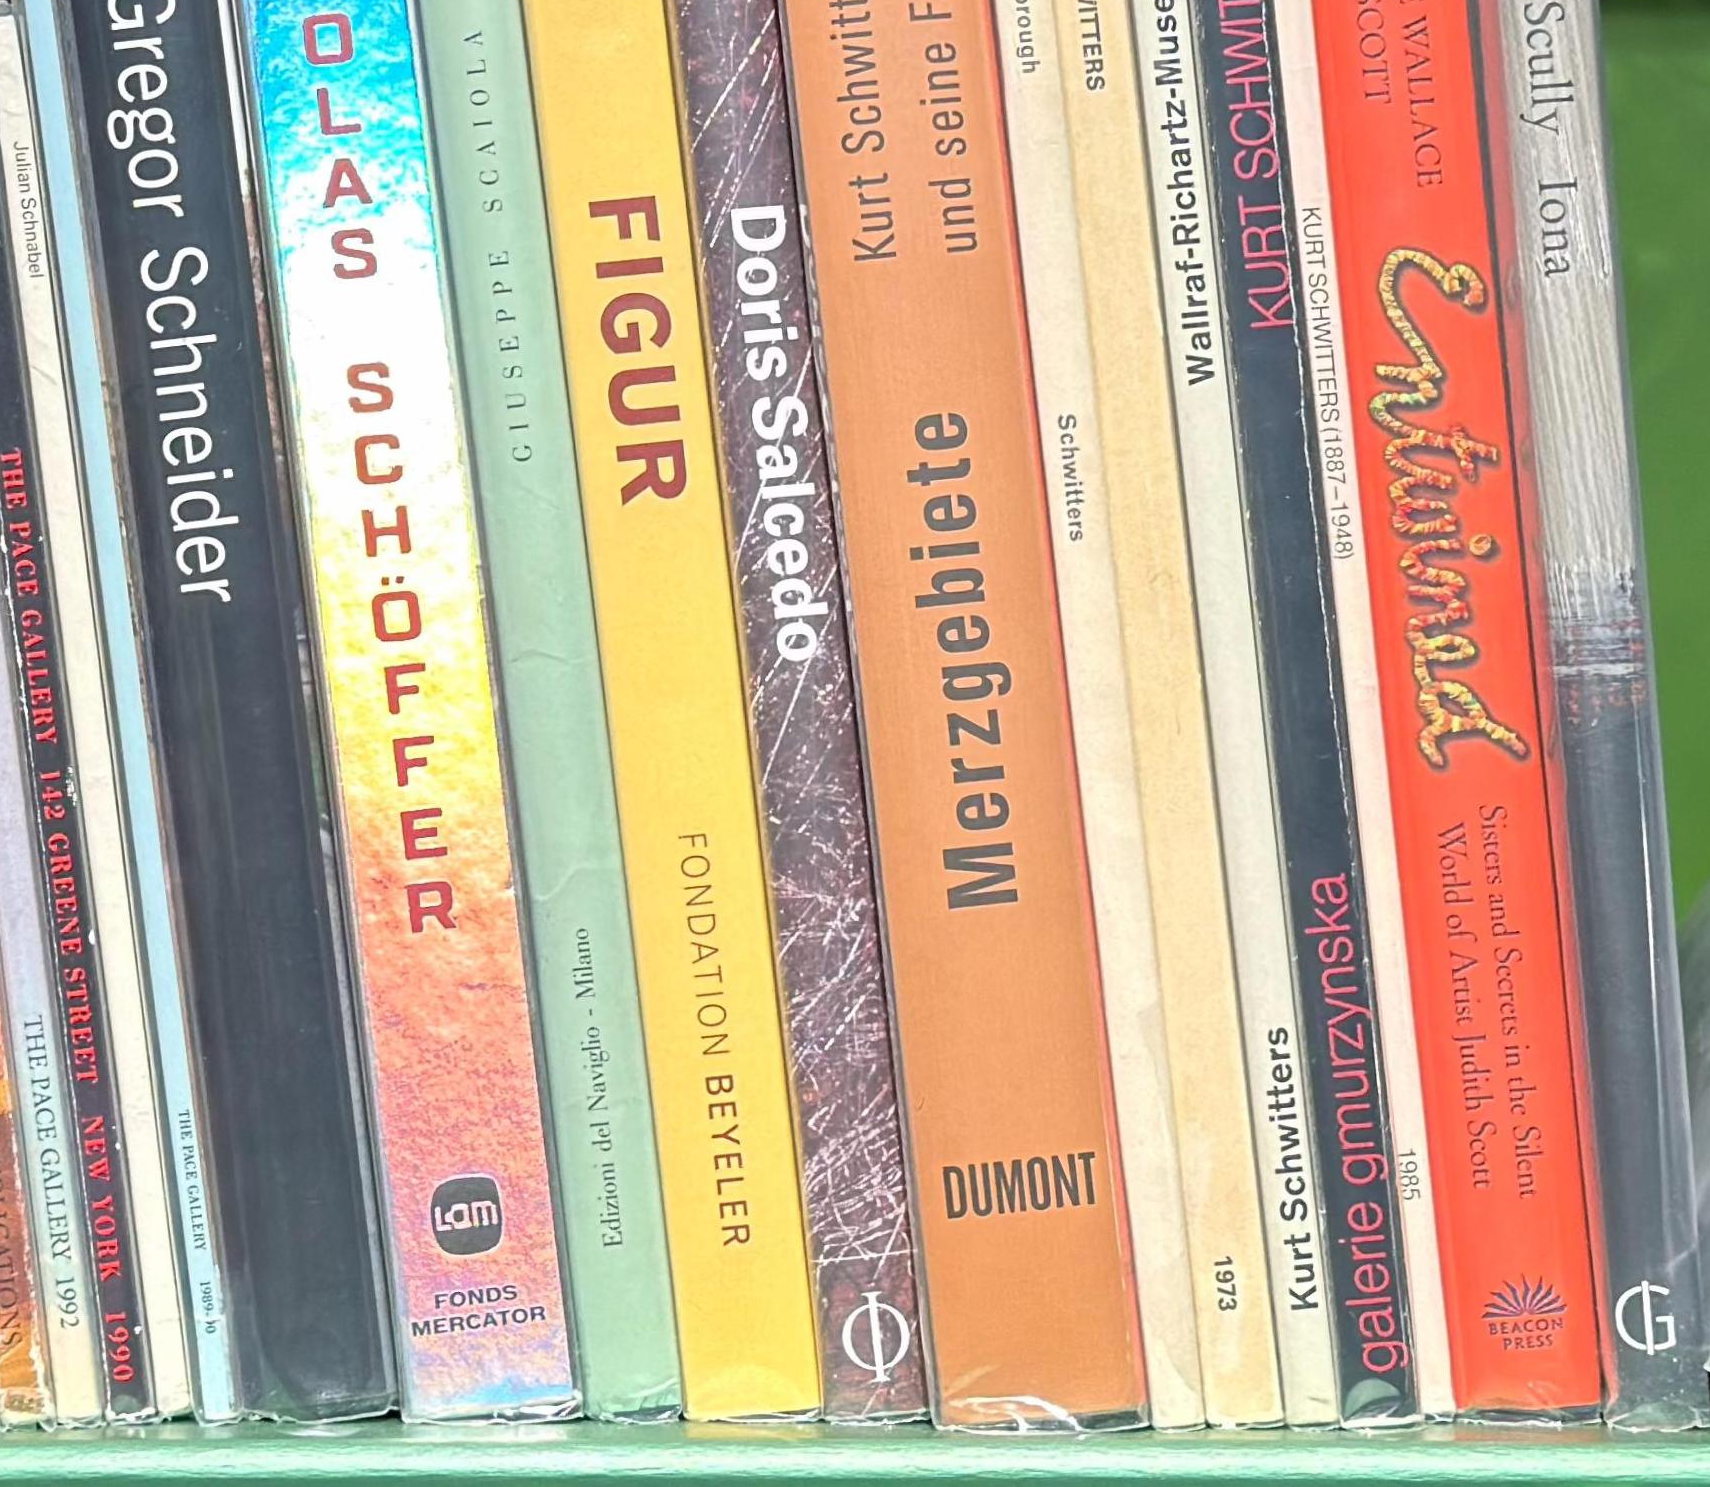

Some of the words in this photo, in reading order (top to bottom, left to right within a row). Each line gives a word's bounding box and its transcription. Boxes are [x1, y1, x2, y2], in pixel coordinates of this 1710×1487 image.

[920, 43, 966, 155] seine
[1402, 15, 1442, 186] WALLACE
[1512, 0, 1575, 137] Scully
[463, 31, 501, 211] SCAIOLA
[13, 141, 39, 192] Julian
[21, 192, 50, 278] Schnabel
[848, 172, 896, 260] Kurt
[928, 178, 976, 252] und
[1302, 207, 1325, 268] KURT
[1536, 176, 1583, 278] Iona
[729, 203, 802, 382] Doris
[1240, 193, 1293, 329] KURT
[488, 251, 531, 461] GIUSEPPE
[588, 195, 686, 505] FIGUR
[1308, 273, 1339, 422] SCHWITTERS
[140, 247, 238, 601] Schneider
[0, 447, 26, 508] THE
[1057, 414, 1084, 541] Schwitters
[1367, 245, 1529, 770] Entwined
[9, 521, 38, 596] PACE
[749, 392, 832, 664] Salcedo
[20, 609, 56, 743] GALLERY
[347, 363, 458, 933] SCHÖFFER
[906, 413, 1017, 908] Merzgebiete
[40, 771, 64, 819] 142
[1437, 822, 1473, 903] World
[1479, 805, 1507, 884] Sisters
[47, 833, 81, 954] GREENE
[1488, 894, 1519, 936] and
[572, 928, 594, 998] Milano
[1449, 950, 1479, 1022] Artist
[1494, 947, 1522, 1035] Secrets
[24, 1014, 47, 1069] THE
[64, 967, 98, 1083] STREET
[678, 833, 729, 1054] FONDATION
[705, 1074, 749, 1245] BEYELER
[1305, 871, 1386, 1184] gmurzynska
[31, 1077, 56, 1140] PACE
[581, 1026, 608, 1110] Naviglio
[1452, 1034, 1493, 1110] Judith
[81, 1116, 109, 1180] NEW
[177, 1109, 193, 1140] THE
[181, 1144, 198, 1180] PACE
[590, 1122, 611, 1151] del
[1266, 1027, 1307, 1220] Schwitters
[1467, 1120, 1496, 1187] Scott
[1512, 1126, 1542, 1195] Silent
[40, 1148, 70, 1259] GALLERY
[598, 1163, 622, 1245] Edizioni
[943, 1152, 1096, 1220] DUMONT
[1391, 1148, 1420, 1200] 1985
[91, 1195, 120, 1281] YORK
[185, 1184, 207, 1251] GALLERY
[55, 1277, 78, 1327] 1992
[434, 1285, 518, 1310] FONDS
[1214, 1256, 1236, 1310] 1973
[1284, 1232, 1317, 1310] Kurt
[1339, 1202, 1409, 1373] galerie
[105, 1312, 133, 1381] 1990
[411, 1306, 547, 1338] MERCATOR
[1489, 1317, 1563, 1335] BEACON
[1503, 1334, 1553, 1350] PRESS
